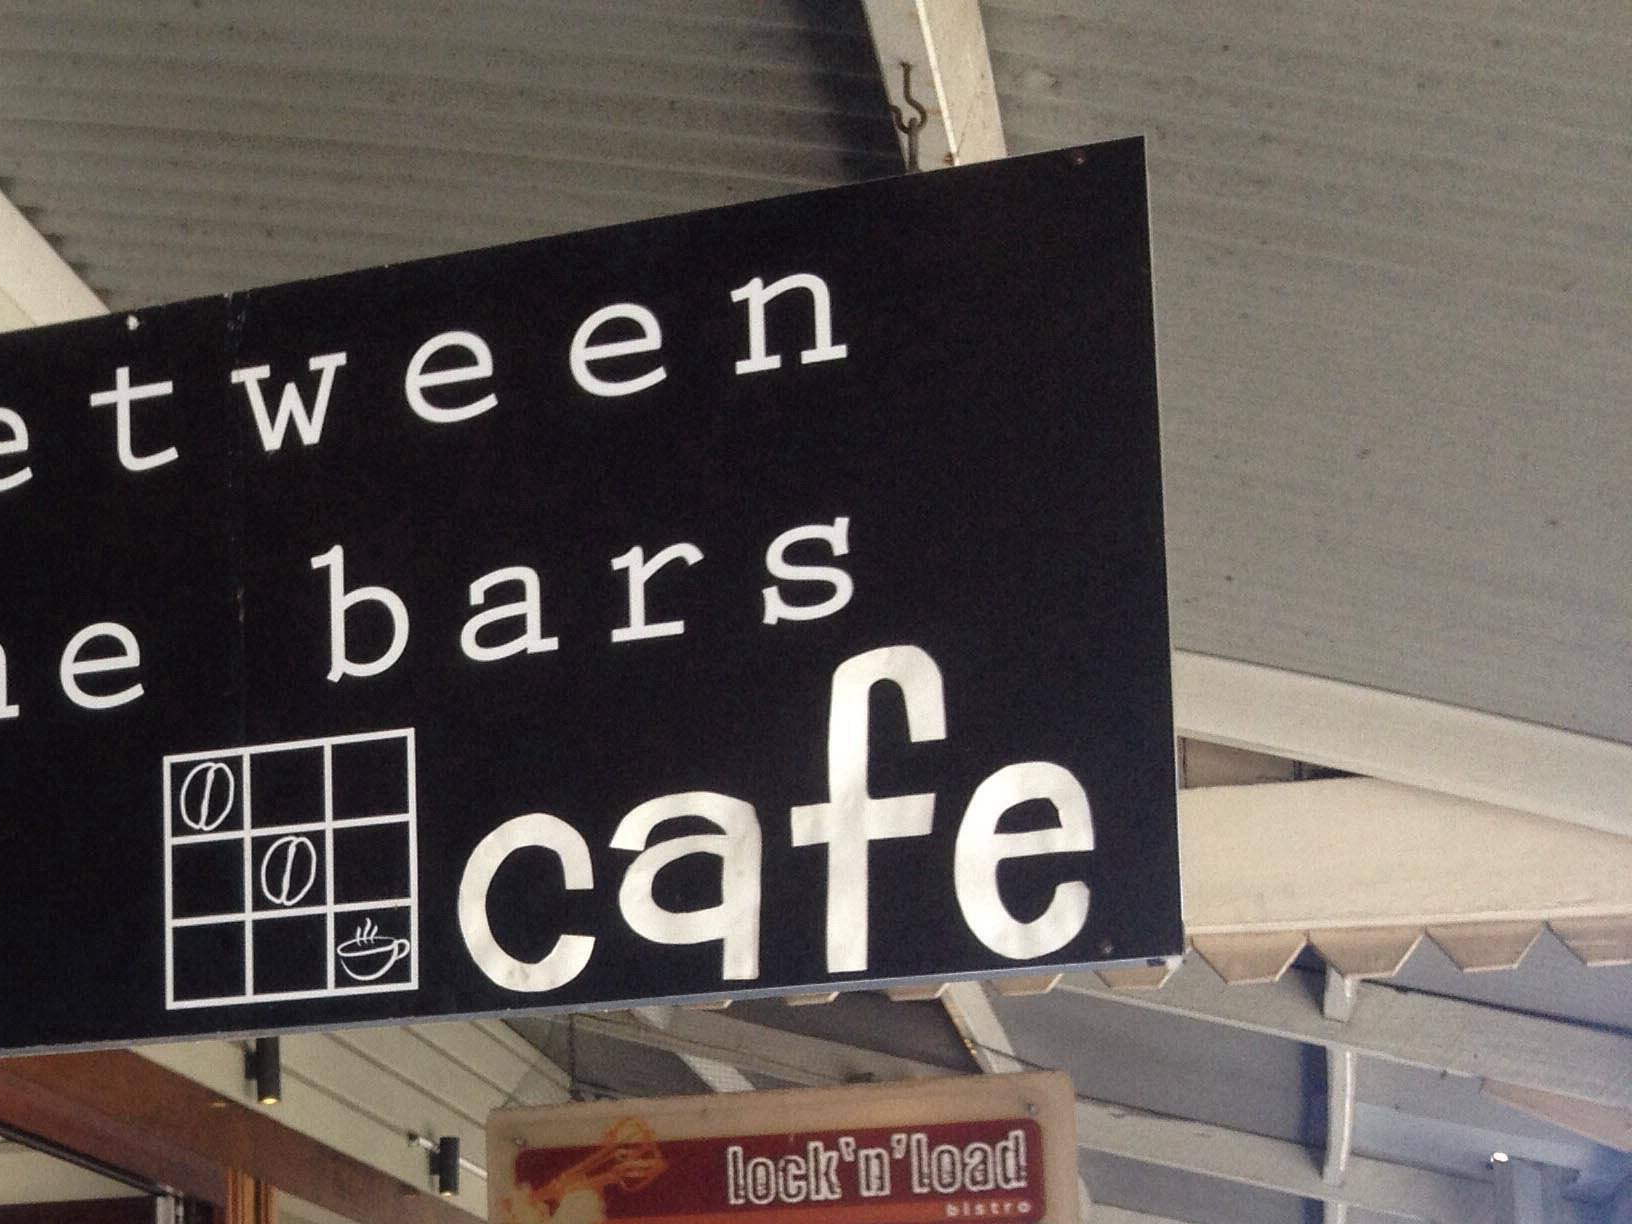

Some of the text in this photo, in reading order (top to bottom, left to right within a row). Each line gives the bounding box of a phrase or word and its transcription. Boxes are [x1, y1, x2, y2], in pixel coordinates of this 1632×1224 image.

[310, 516, 855, 683] bars
[456, 644, 1097, 993] cafe
[945, 1200, 1032, 1218] bistro
